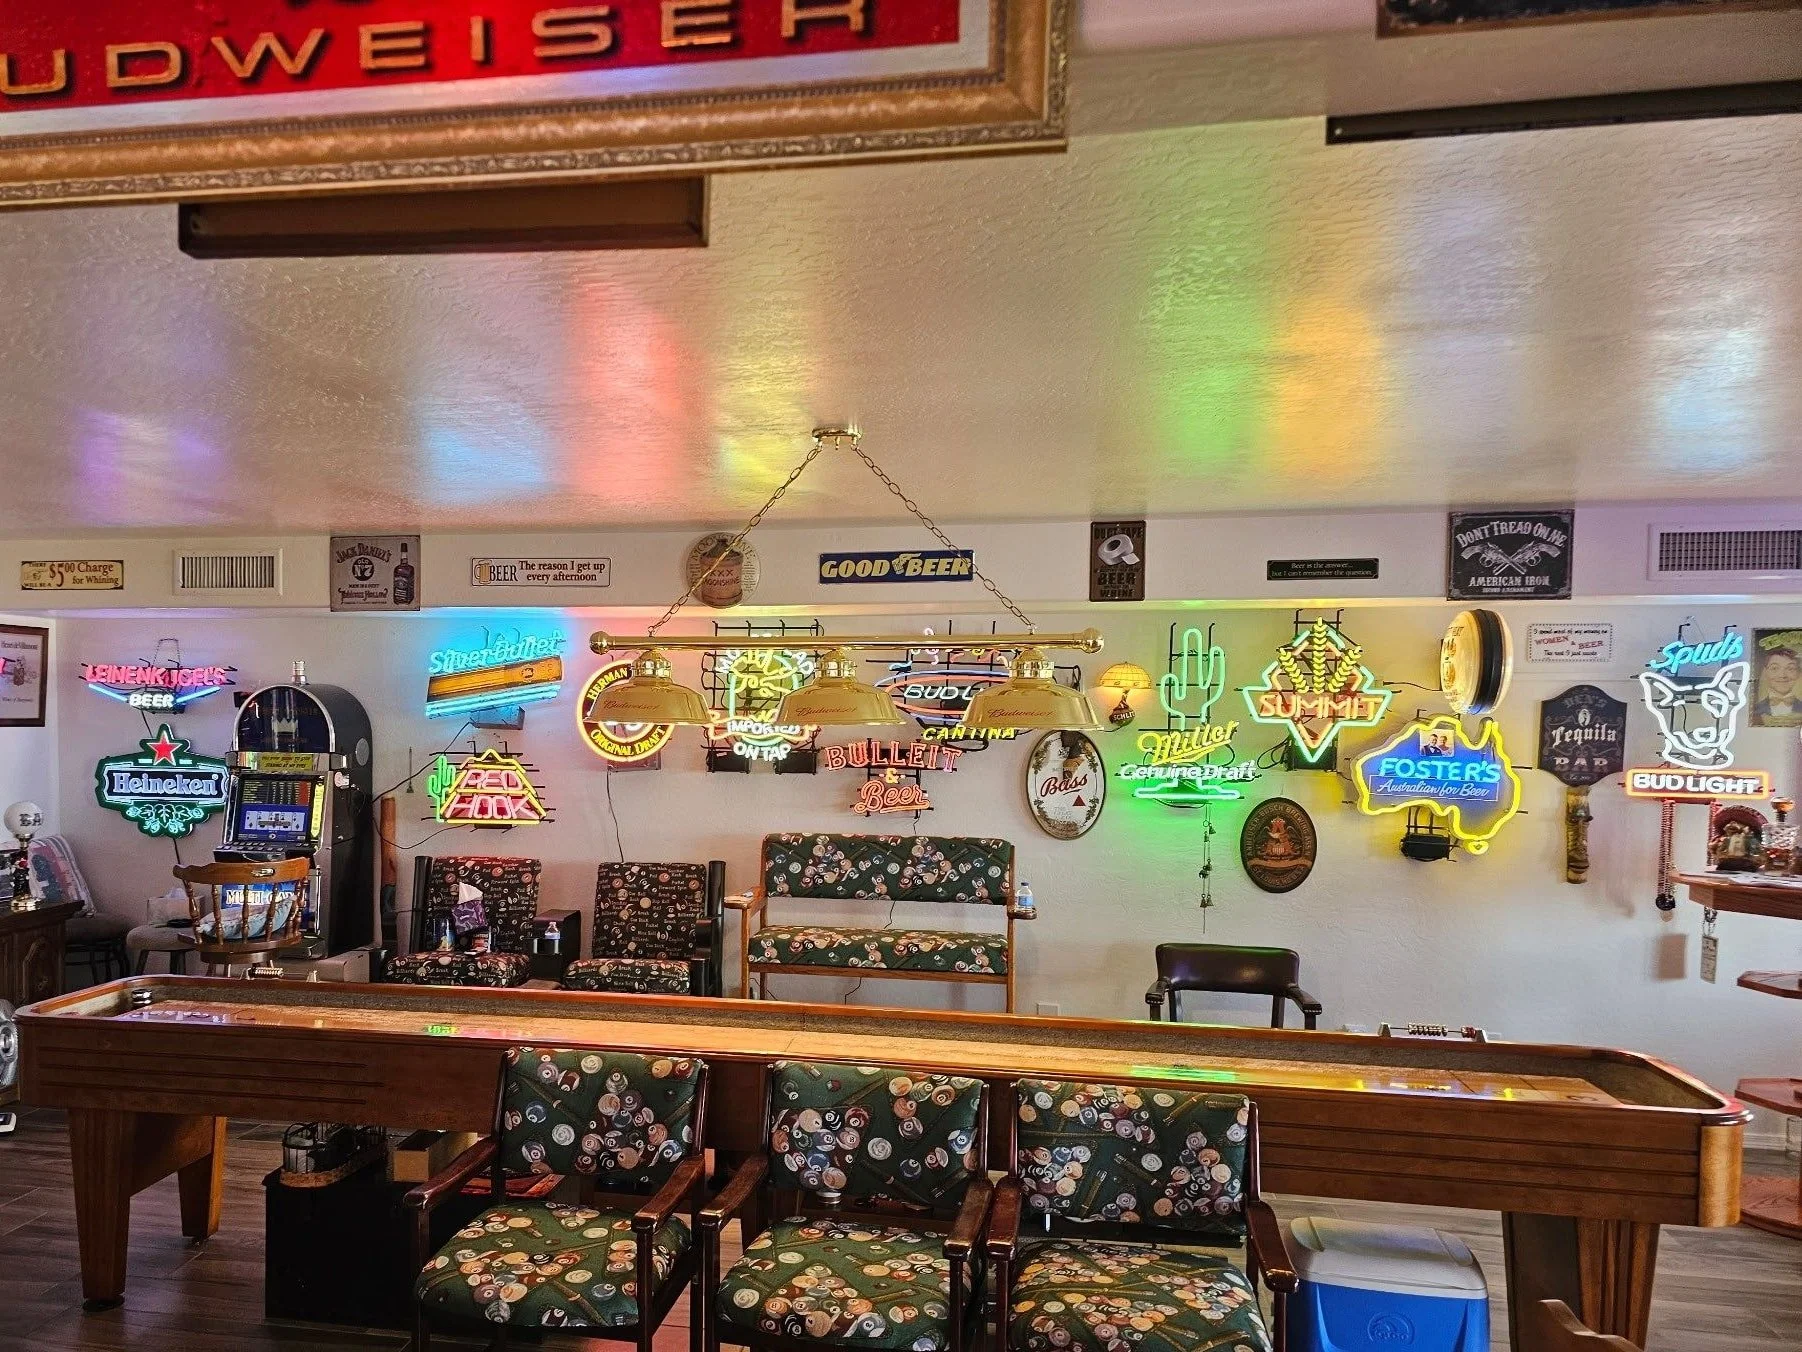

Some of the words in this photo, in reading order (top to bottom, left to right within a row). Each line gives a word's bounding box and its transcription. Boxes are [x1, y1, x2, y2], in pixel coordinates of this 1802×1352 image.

[1490, 520, 1532, 536] TREAD
[335, 546, 357, 563] JACK
[357, 542, 393, 562] DANIEL'S
[78, 562, 114, 579] Charge
[489, 564, 518, 582] BEER
[520, 560, 534, 570] The
[536, 562, 568, 570] reason
[570, 560, 574, 570] I
[576, 562, 591, 574] get
[594, 562, 605, 574] up
[821, 560, 890, 578] GOOD
[904, 558, 972, 576] BEER
[72, 575, 84, 584] for
[85, 574, 119, 586] Whining
[526, 573, 550, 584] every
[553, 572, 597, 582] afternoon
[1098, 572, 1136, 585] BEER
[1468, 576, 1522, 586] AMERICAN
[1525, 576, 1550, 586] IRON
[429, 648, 495, 674] Silver
[492, 630, 566, 662] Bullet
[1534, 636, 1569, 645] WOMEN
[1578, 640, 1604, 649] BEER
[588, 667, 629, 701] HERMAN
[904, 684, 960, 700] BUD
[129, 694, 174, 708] BEER
[604, 700, 660, 711] Budweiser
[796, 705, 858, 716] Budweiser
[1259, 694, 1384, 720] SUMMIT
[987, 708, 1057, 718] Budweiser
[590, 729, 634, 756] ORIGINAL
[634, 726, 668, 756] DRAFT
[922, 724, 1016, 741] CANTINA
[1137, 720, 1240, 764] Miller
[1551, 722, 1617, 748] Tequila
[734, 742, 759, 760] ON
[760, 744, 792, 762] TAP
[826, 742, 963, 772] BULLEIT
[460, 768, 524, 790] RED
[886, 768, 898, 784] &
[1118, 762, 1200, 781] Genuine
[1200, 760, 1258, 780] Draft
[1378, 757, 1502, 783] FOSTER'S
[112, 772, 218, 796] Heineken
[1040, 773, 1088, 798] Bass
[1378, 781, 1440, 798] Australian
[1438, 782, 1460, 798] for
[1460, 784, 1490, 798] Beer
[1634, 774, 1685, 790] BUD
[1686, 774, 1760, 794] LIGHT
[854, 780, 931, 813] Beer
[446, 795, 540, 820] HOOK
